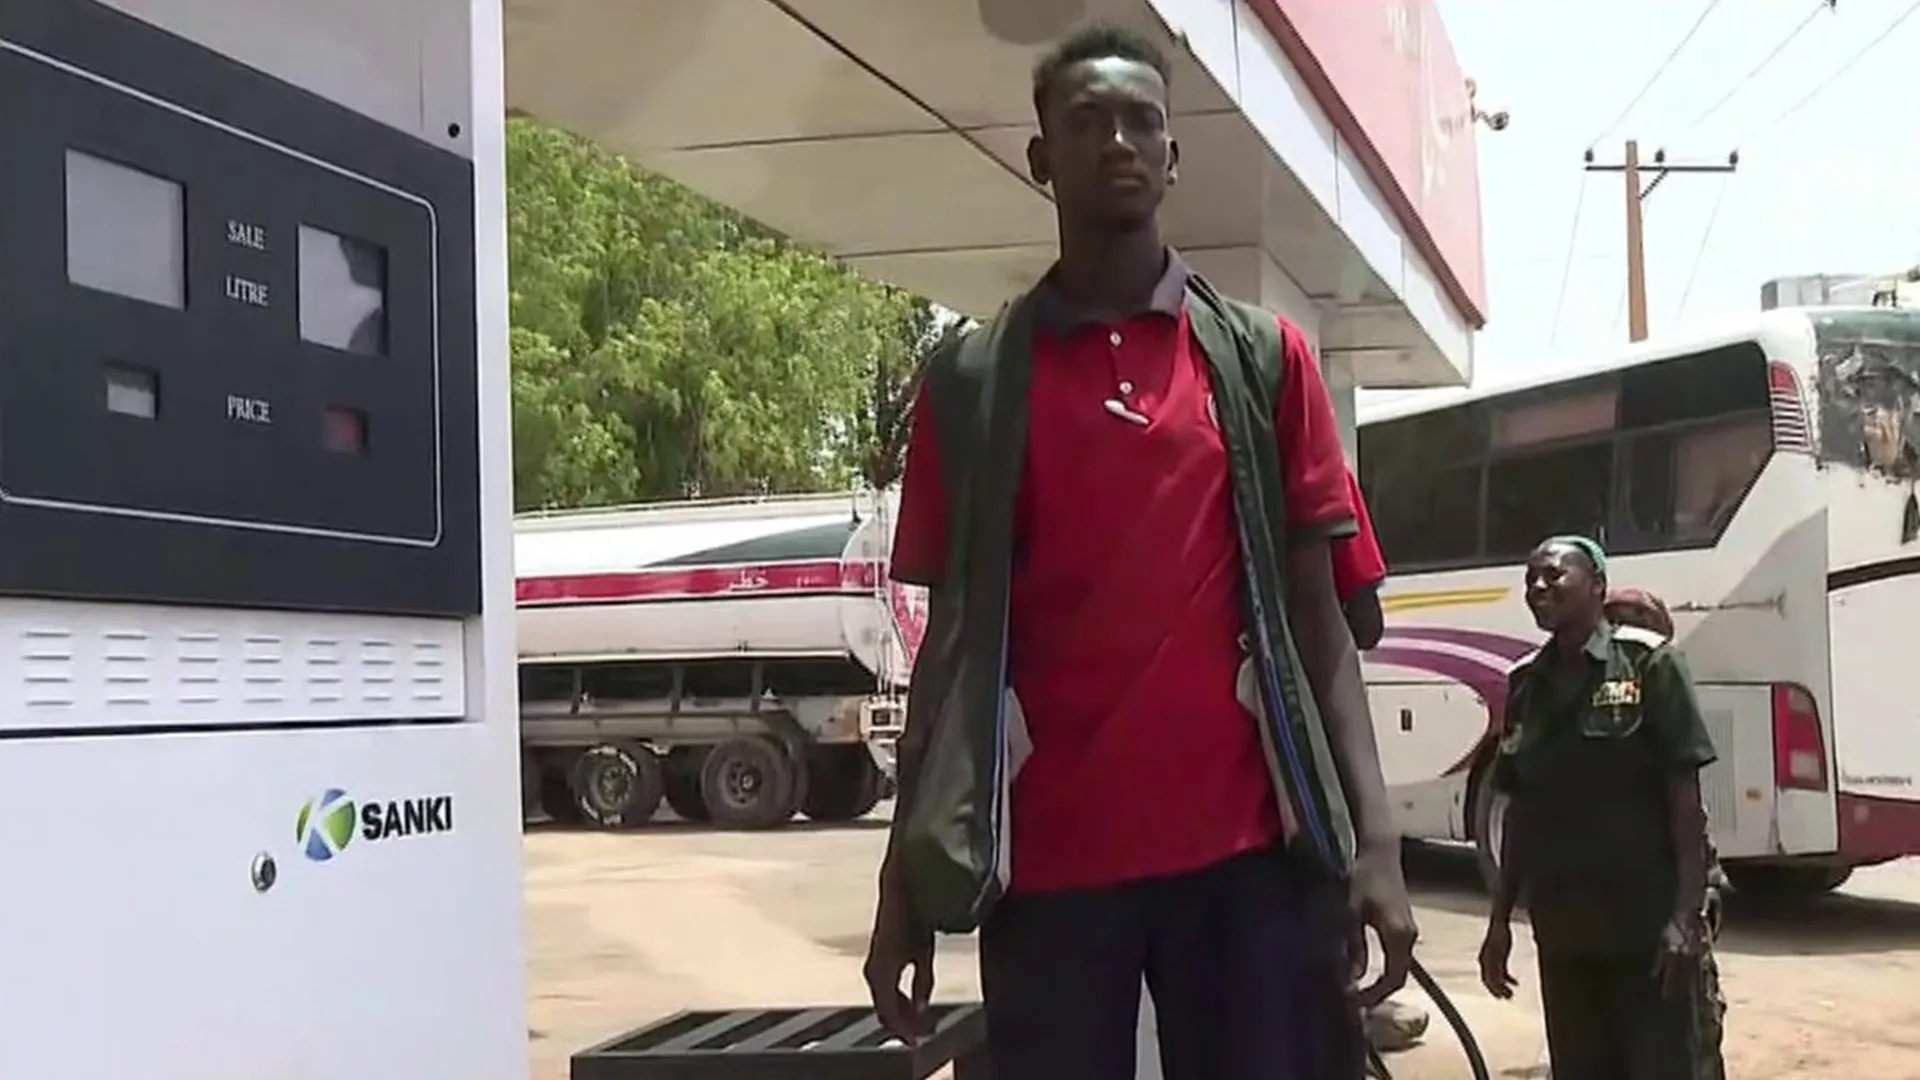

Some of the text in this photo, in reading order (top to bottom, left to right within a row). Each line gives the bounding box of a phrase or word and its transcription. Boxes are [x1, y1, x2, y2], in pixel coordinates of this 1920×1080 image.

[227, 219, 265, 250] SALE
[226, 274, 269, 307] LITRE
[227, 395, 272, 423] PRICE
[361, 796, 453, 840] SANKI
